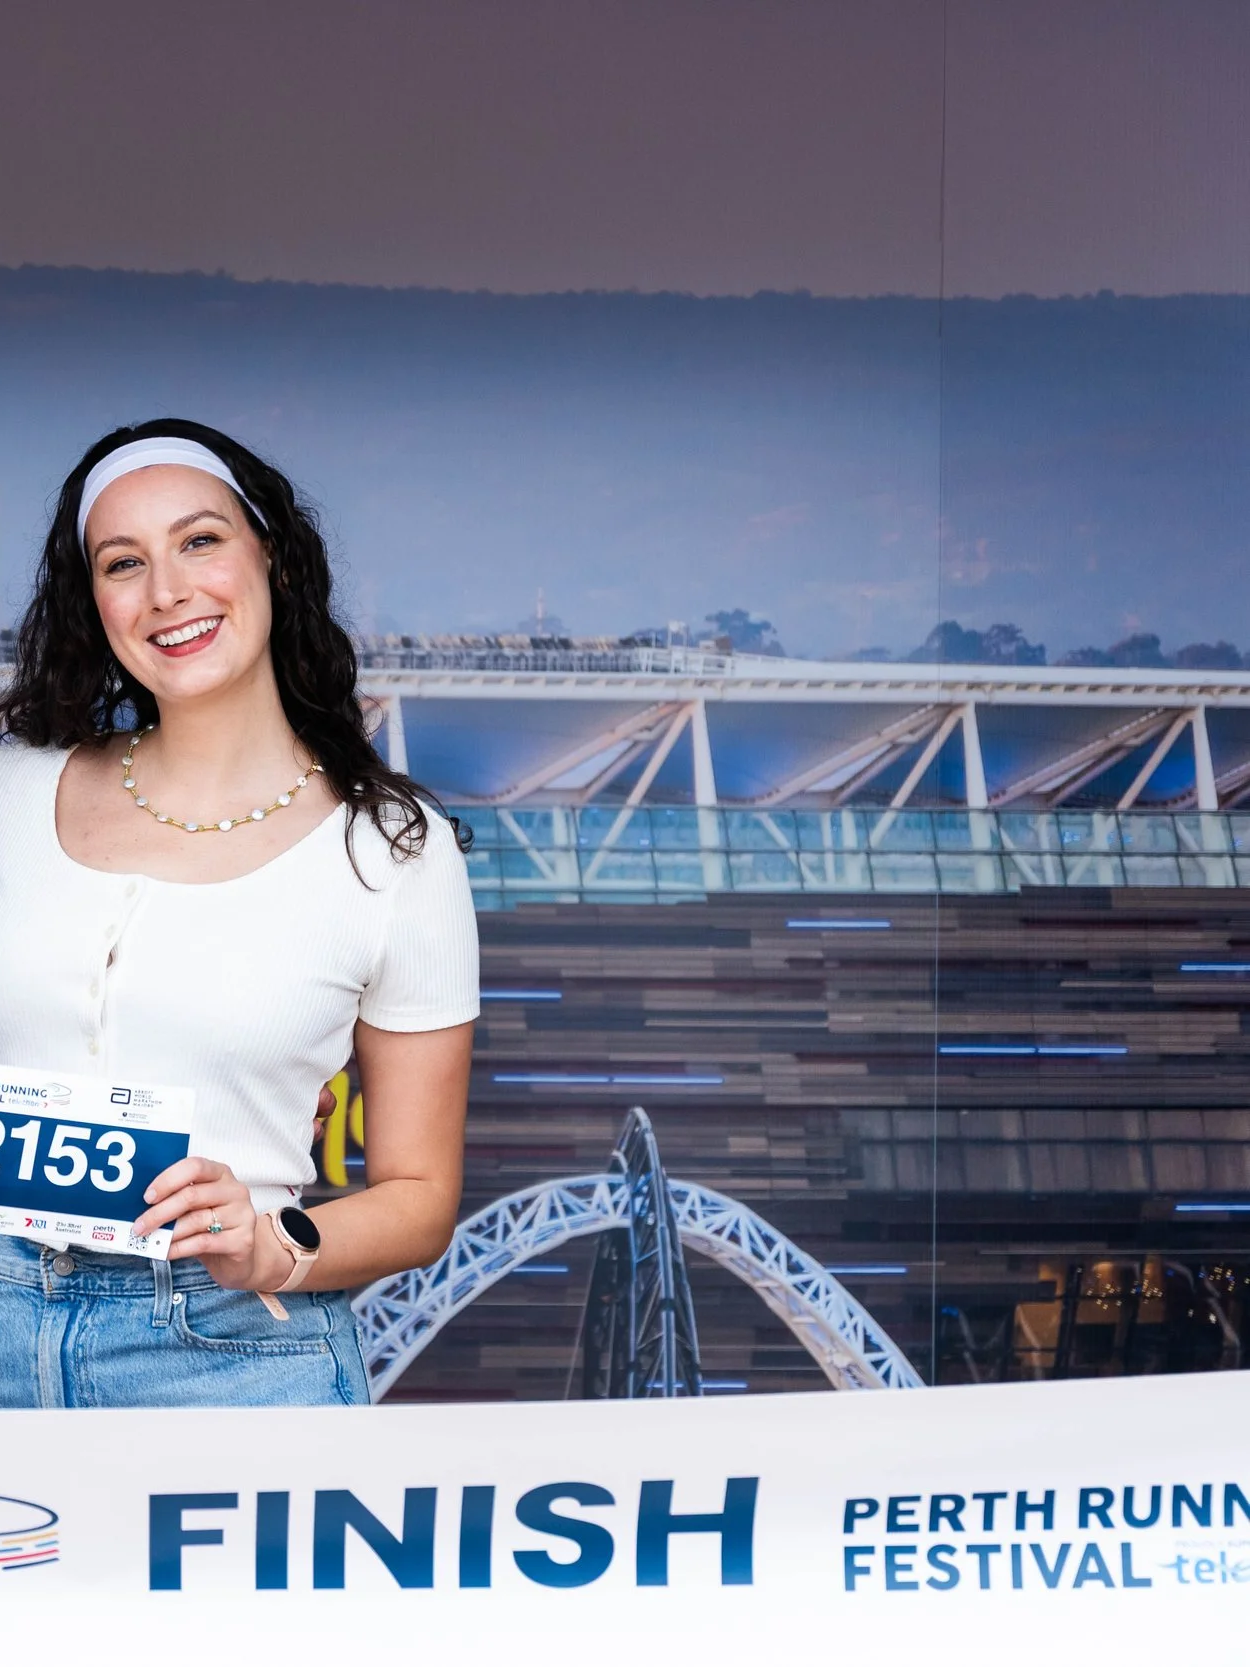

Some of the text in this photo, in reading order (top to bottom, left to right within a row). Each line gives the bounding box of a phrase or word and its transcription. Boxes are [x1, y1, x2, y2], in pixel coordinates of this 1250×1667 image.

[93, 1225, 116, 1233] perth
[93, 1233, 114, 1241] now
[843, 1483, 1250, 1534] PERTH RUNN
[149, 1477, 759, 1591] FINISH
[844, 1542, 1152, 1592] FESTIVAL
